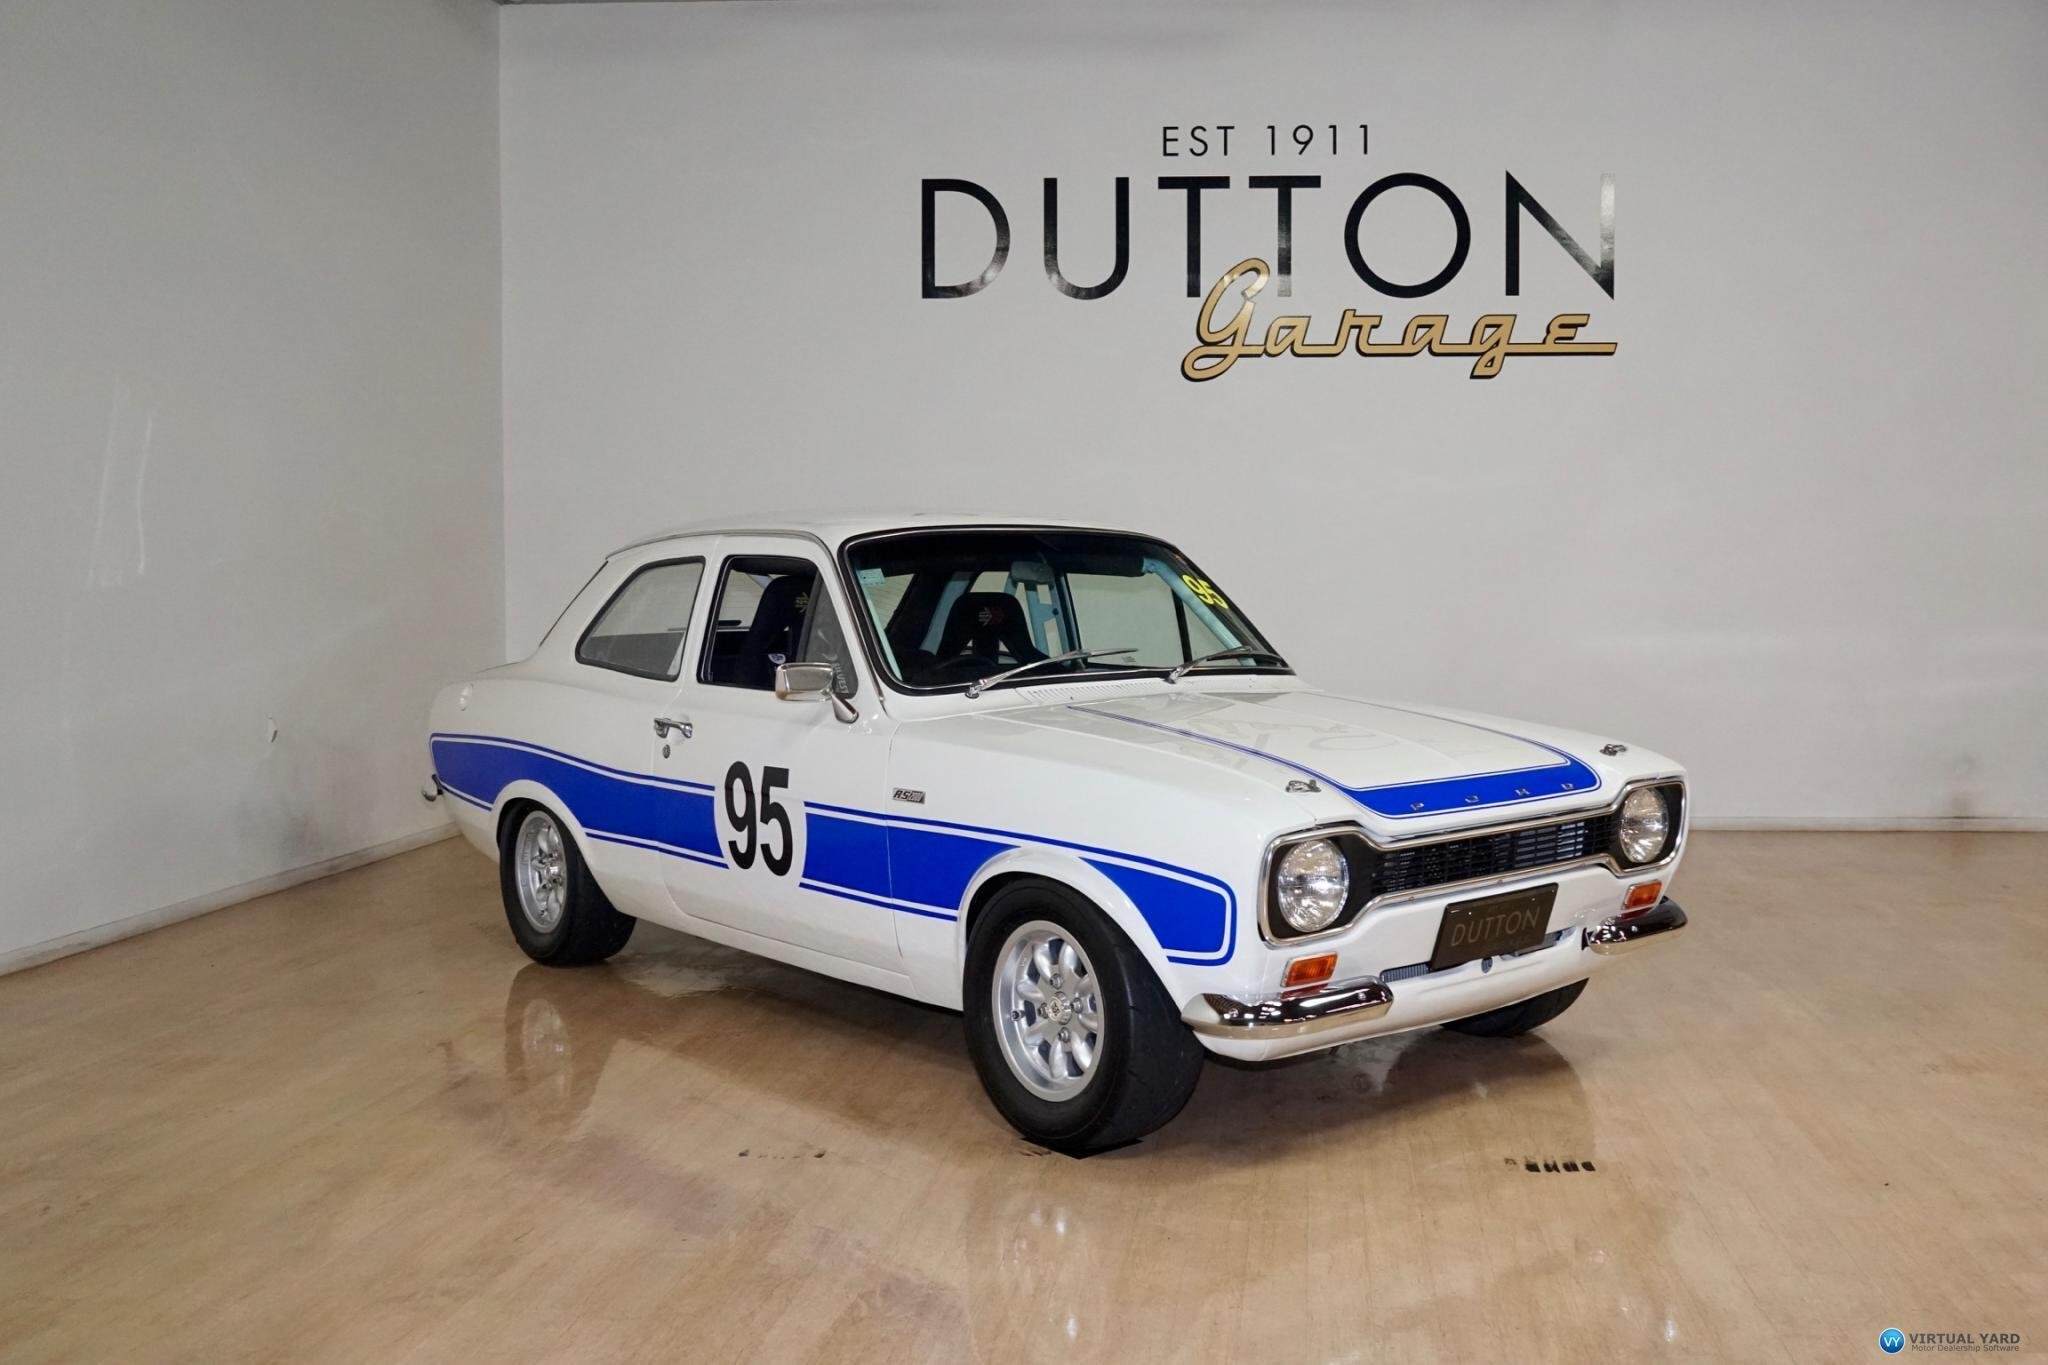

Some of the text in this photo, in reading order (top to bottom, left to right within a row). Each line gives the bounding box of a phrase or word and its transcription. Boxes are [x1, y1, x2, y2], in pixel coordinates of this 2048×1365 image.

[1162, 124, 1369, 157] EST 1911
[921, 170, 1615, 301] DUTTON
[1181, 257, 1618, 382] Garage
[1182, 574, 1229, 609] 95
[724, 761, 793, 876] 95
[1450, 906, 1540, 946] DUTTON
